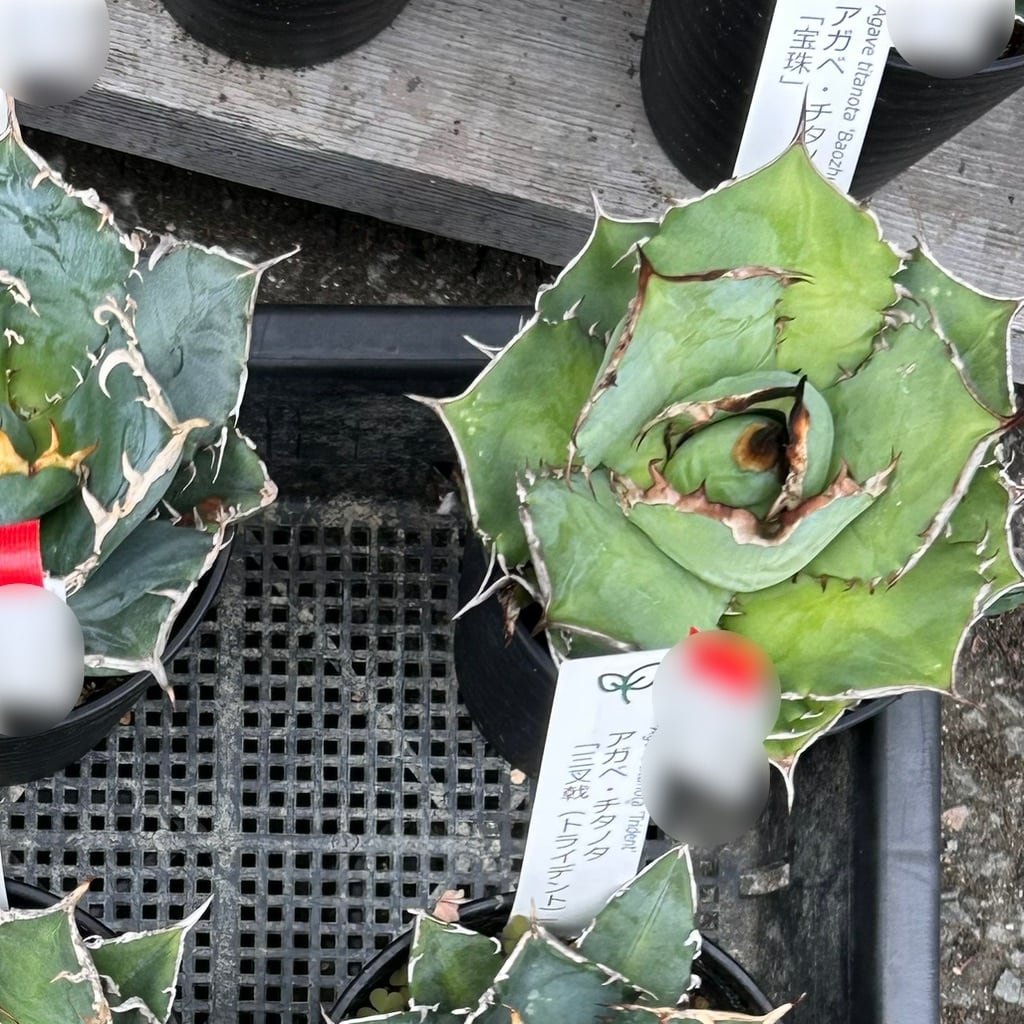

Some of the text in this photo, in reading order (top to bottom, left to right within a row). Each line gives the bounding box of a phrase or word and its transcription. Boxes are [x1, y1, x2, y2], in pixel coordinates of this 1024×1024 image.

[779, 15, 825, 86] 「宝珠」
[861, 4, 886, 56] Agave
[843, 61, 873, 122] titanota
[584, 731, 637, 862] アガベ・チタノタ
